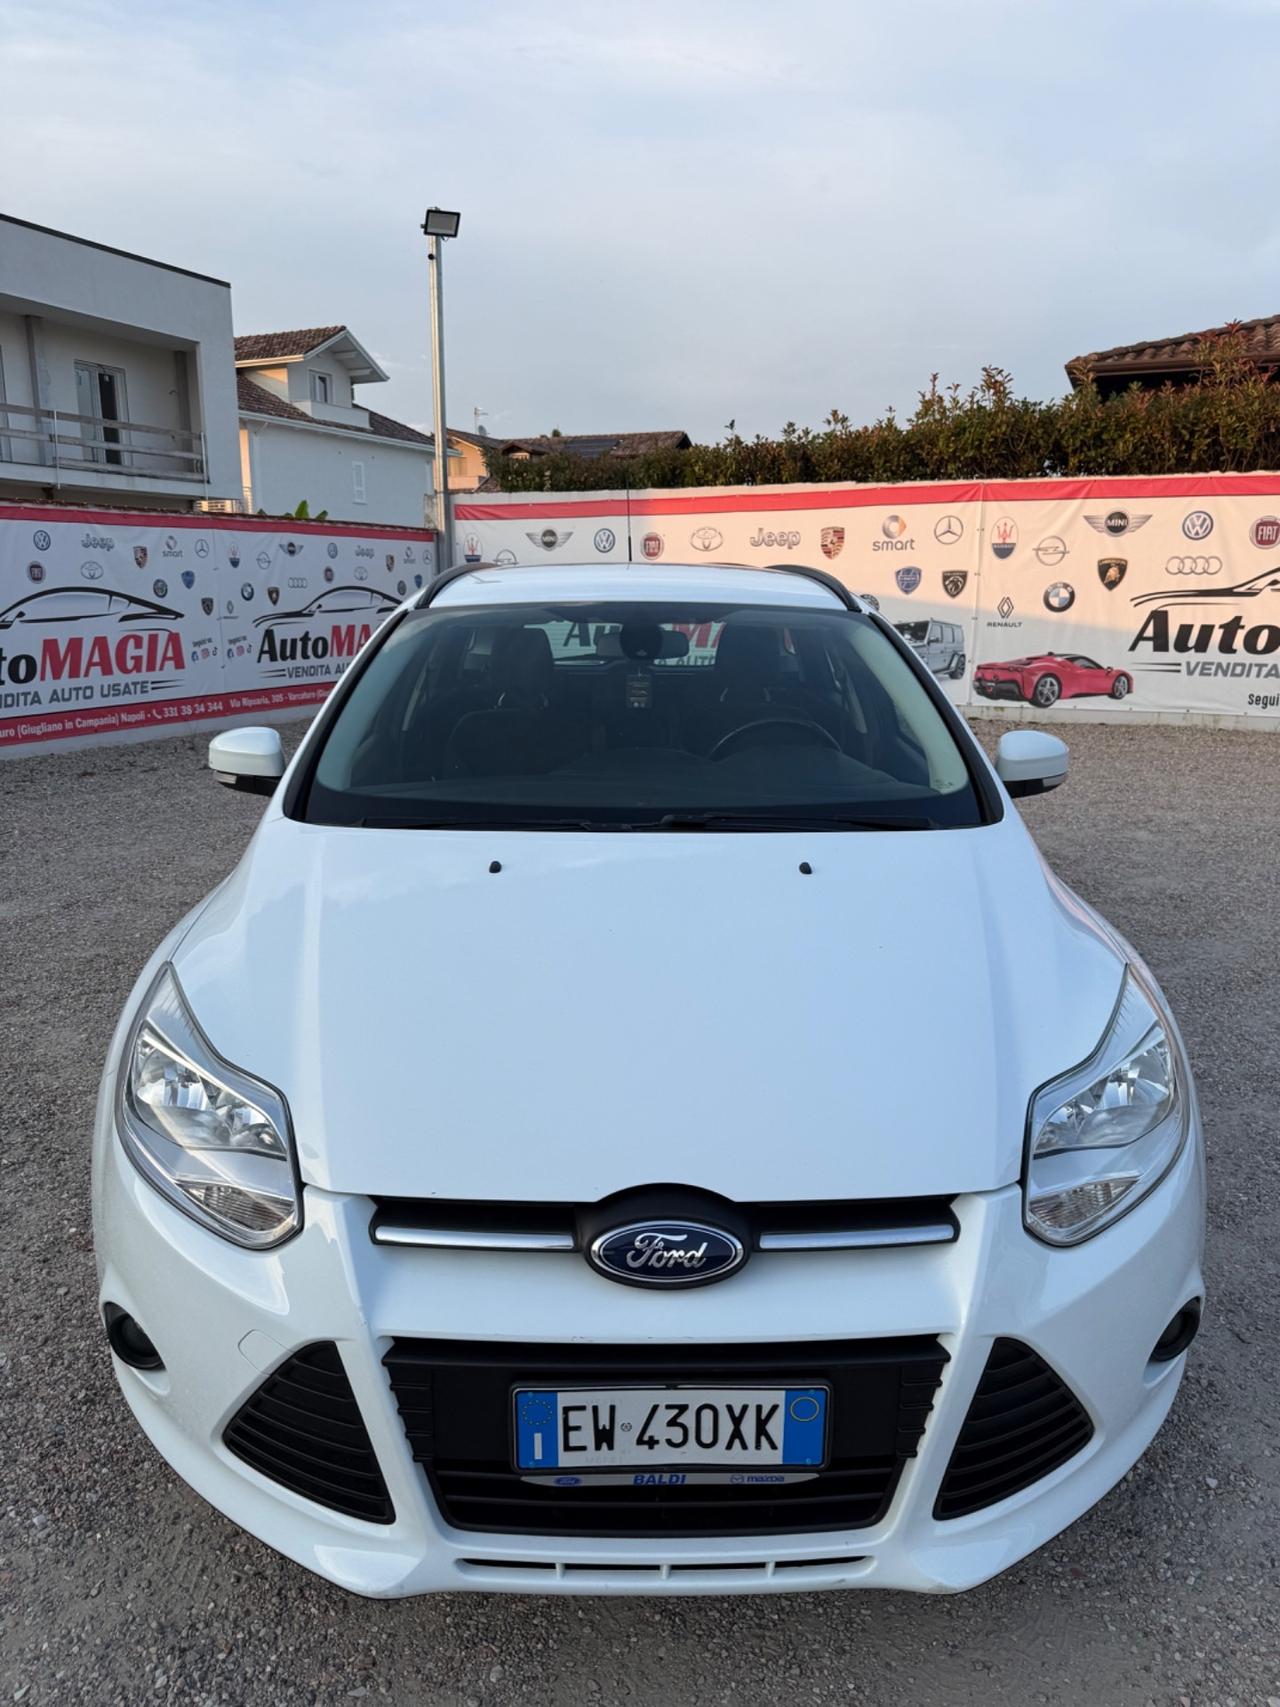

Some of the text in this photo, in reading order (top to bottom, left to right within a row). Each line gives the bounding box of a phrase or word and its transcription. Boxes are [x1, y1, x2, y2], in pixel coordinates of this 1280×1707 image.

[1107, 519, 1128, 527] MINI
[750, 527, 801, 550] Jeep
[1257, 527, 1279, 541] FIAT
[872, 539, 915, 551] smart
[287, 664, 331, 678] VENDITA
[49, 685, 94, 704] AUTO
[100, 680, 150, 698] USATE
[625, 1232, 708, 1269] Ford
[562, 1403, 780, 1452] EW 430XK
[633, 1474, 687, 1486] BALDI
